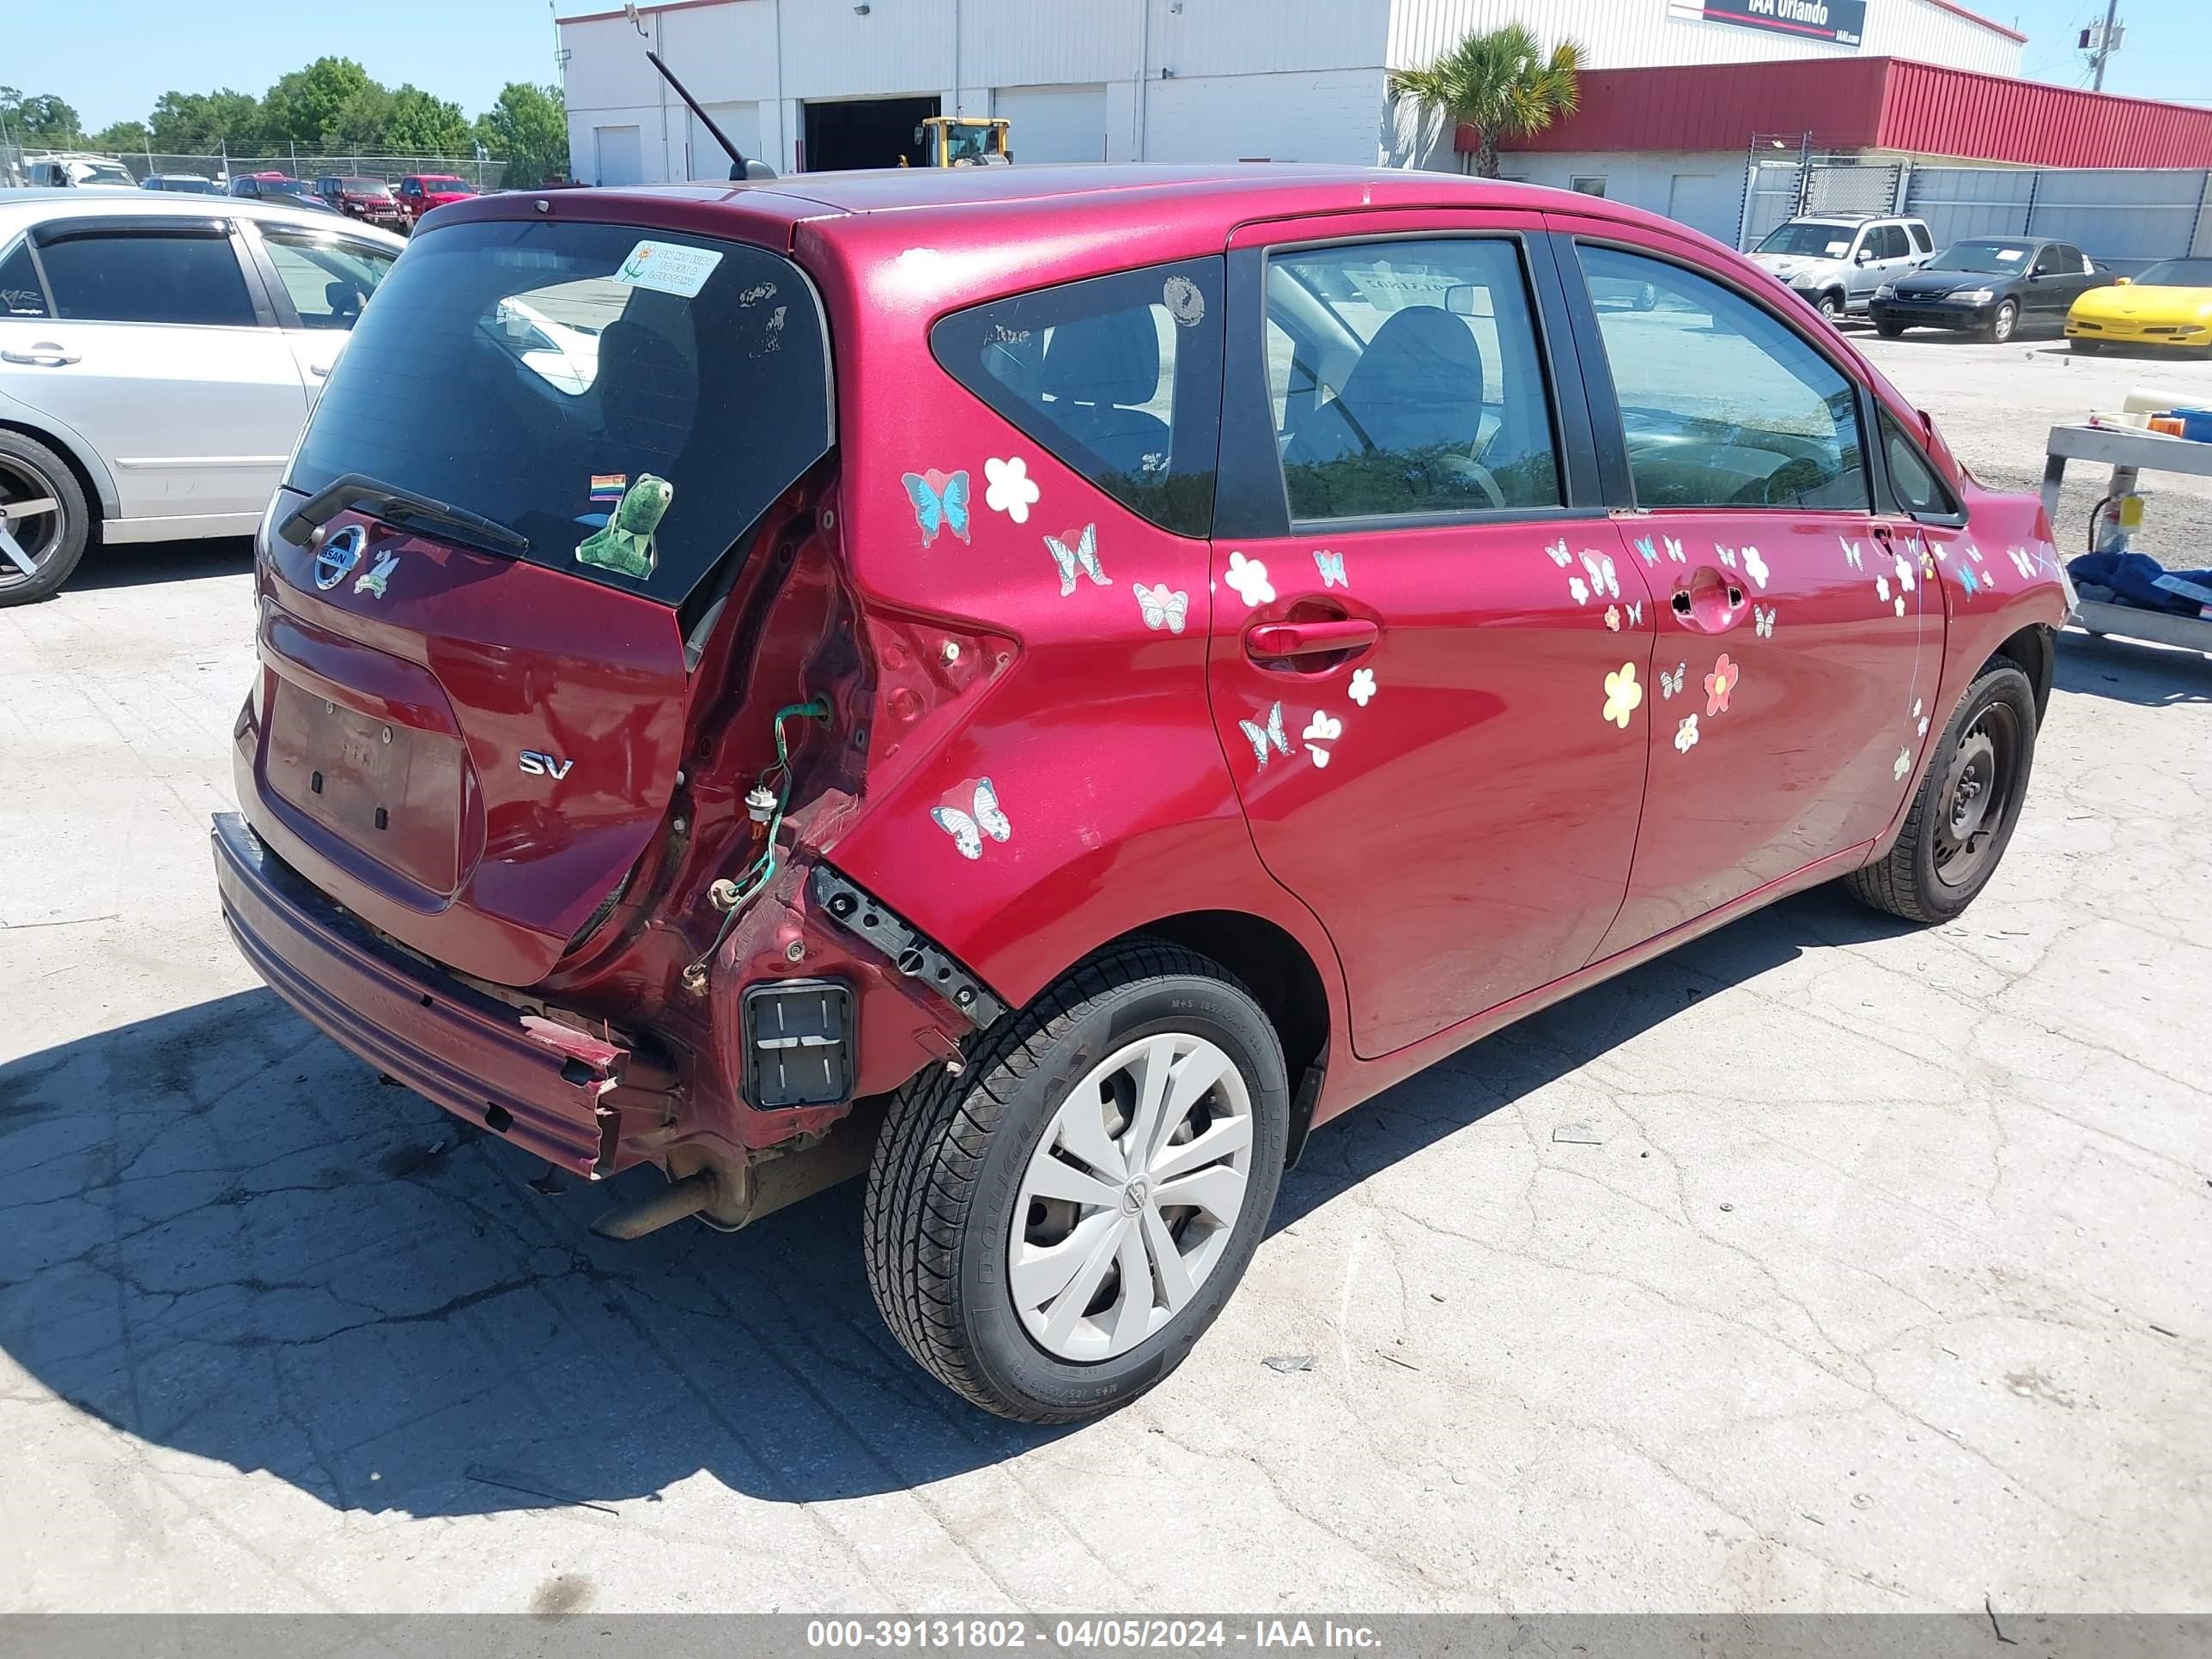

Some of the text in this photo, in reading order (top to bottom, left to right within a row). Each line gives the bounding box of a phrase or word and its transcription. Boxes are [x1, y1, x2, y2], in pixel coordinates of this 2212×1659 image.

[1748, 0, 1828, 26] IAA Orlando
[690, 254, 714, 267] WAY
[690, 266, 698, 276] A
[648, 270, 696, 286] LOBOTOMY
[520, 750, 574, 781] SV
[977, 1042, 1089, 1285] DOUGLAS
